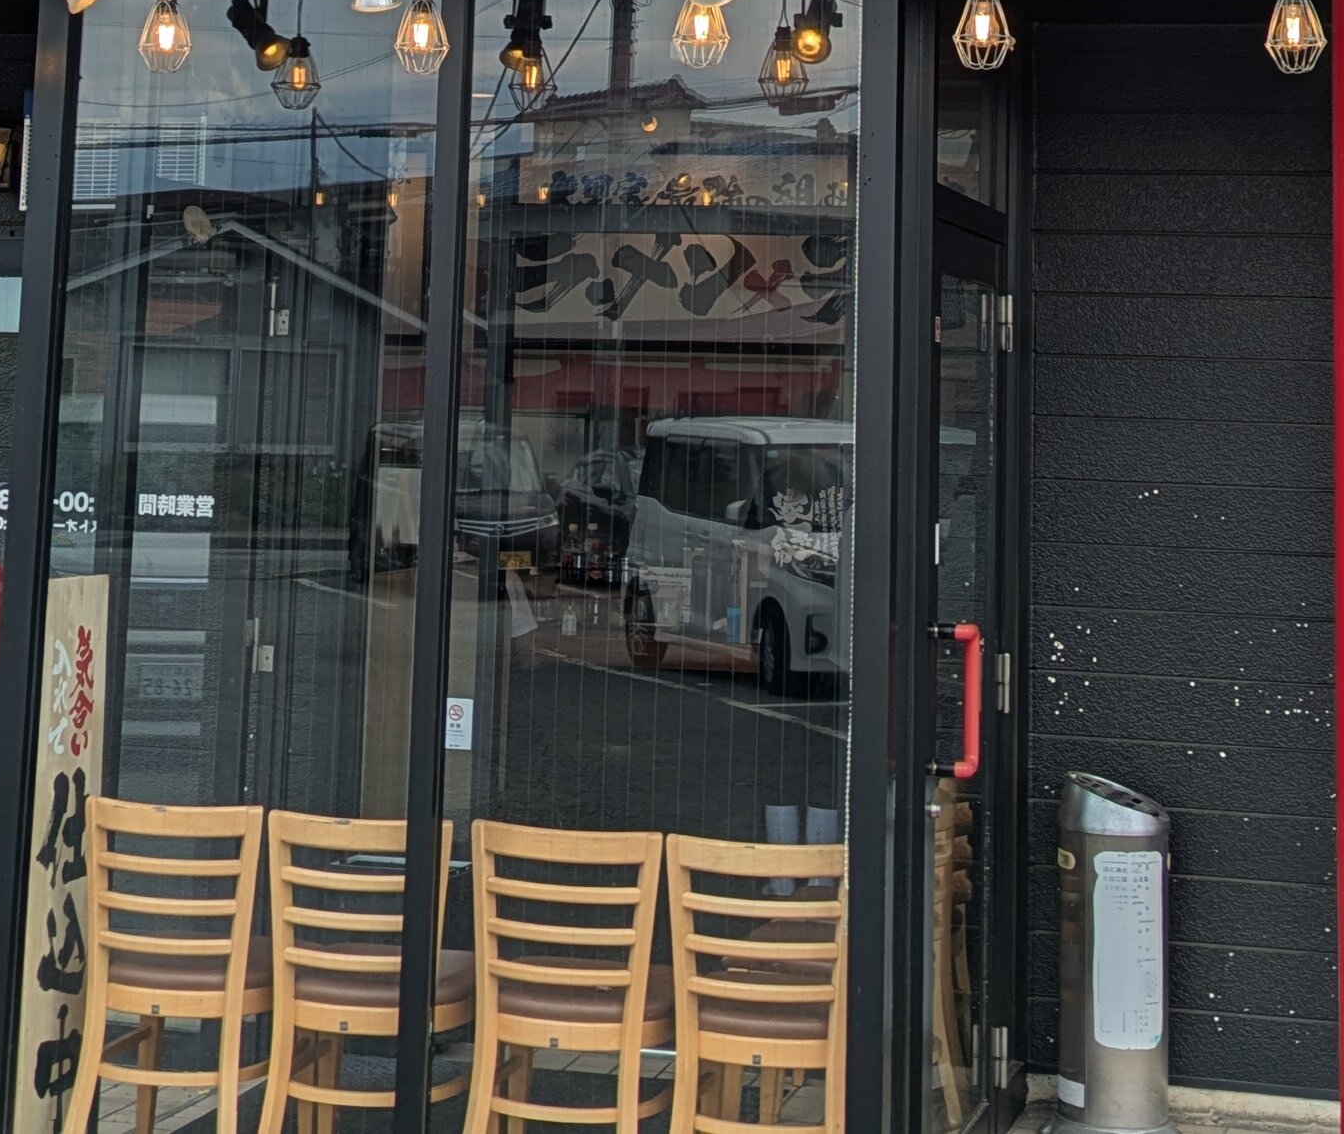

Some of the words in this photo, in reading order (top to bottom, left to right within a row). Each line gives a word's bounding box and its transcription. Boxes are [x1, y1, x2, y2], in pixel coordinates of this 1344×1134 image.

[70, 625, 95, 757] 気合い
[34, 767, 91, 1134] 仕込中
